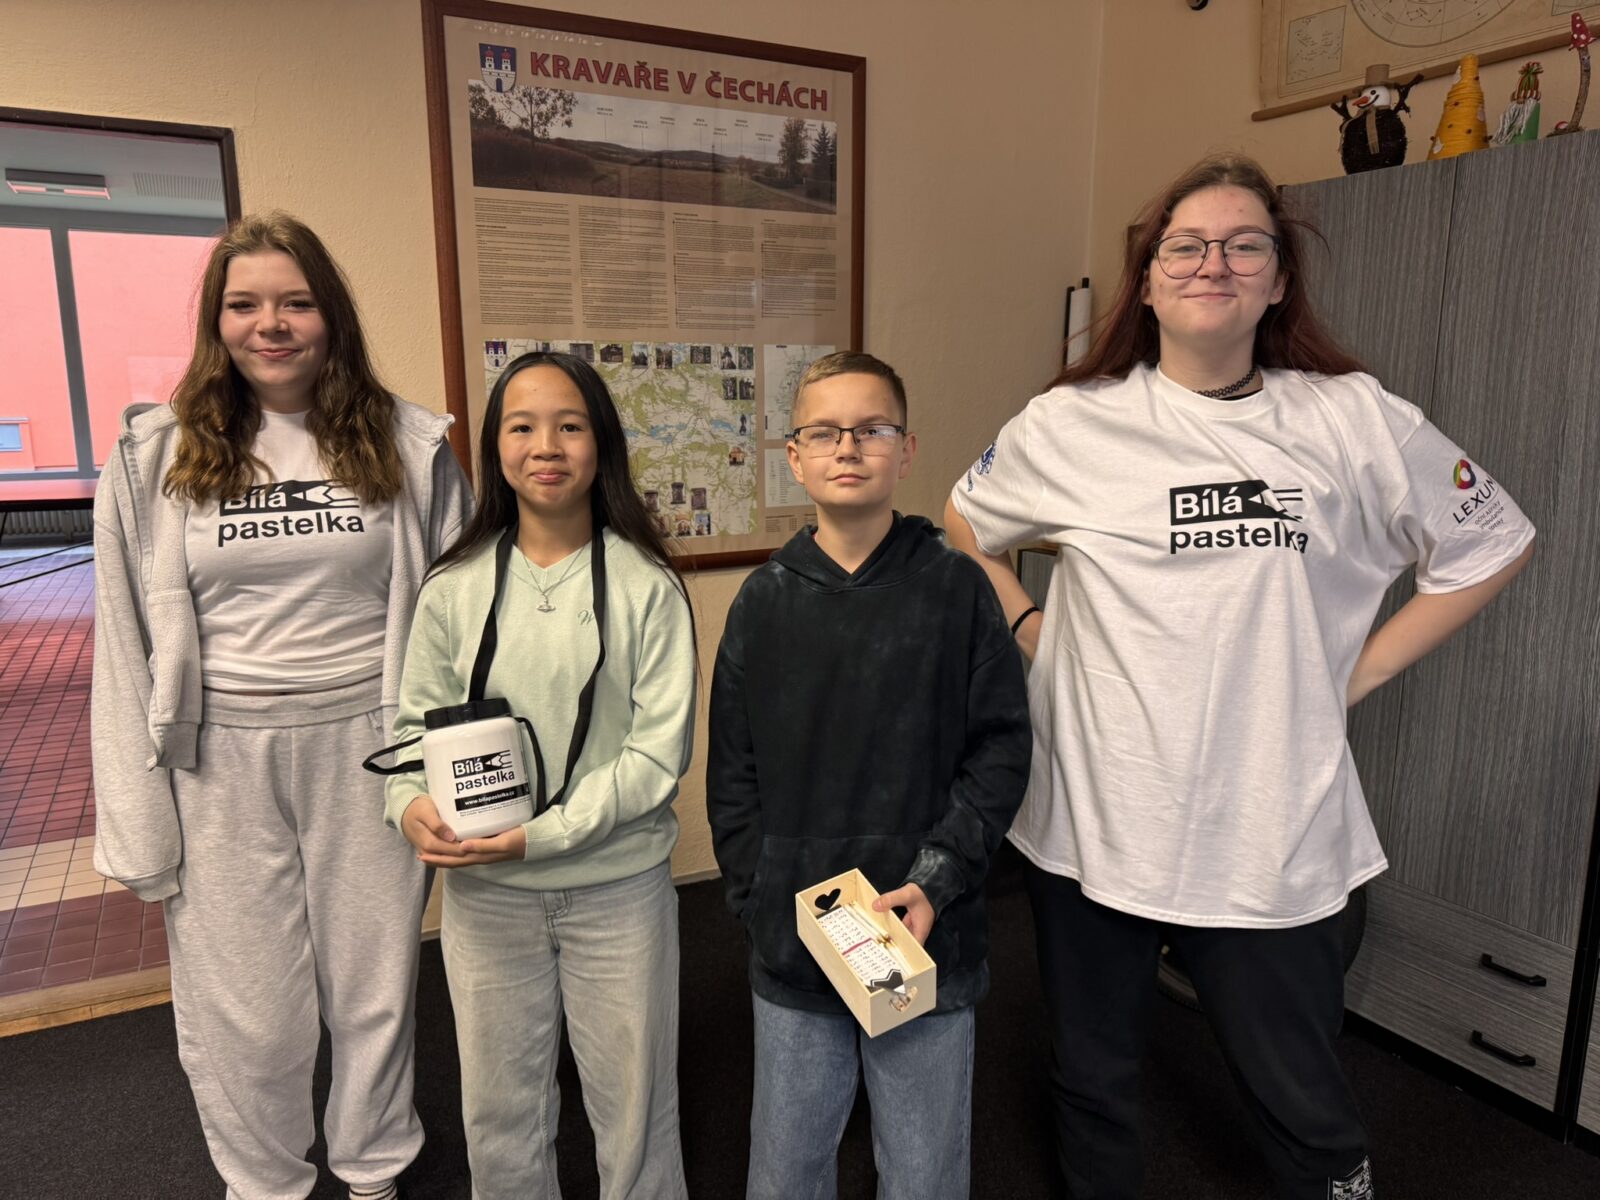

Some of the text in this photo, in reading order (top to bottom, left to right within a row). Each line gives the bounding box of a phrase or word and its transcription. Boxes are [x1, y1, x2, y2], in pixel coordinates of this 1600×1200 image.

[530, 51, 828, 112] KRAVAŘE V ČECHÁCH
[1175, 486, 1243, 519] Bílá
[218, 511, 365, 548] pastelka
[1170, 521, 1309, 554] pastelka
[454, 757, 484, 776] Bílá
[456, 770, 515, 794] pastelka
